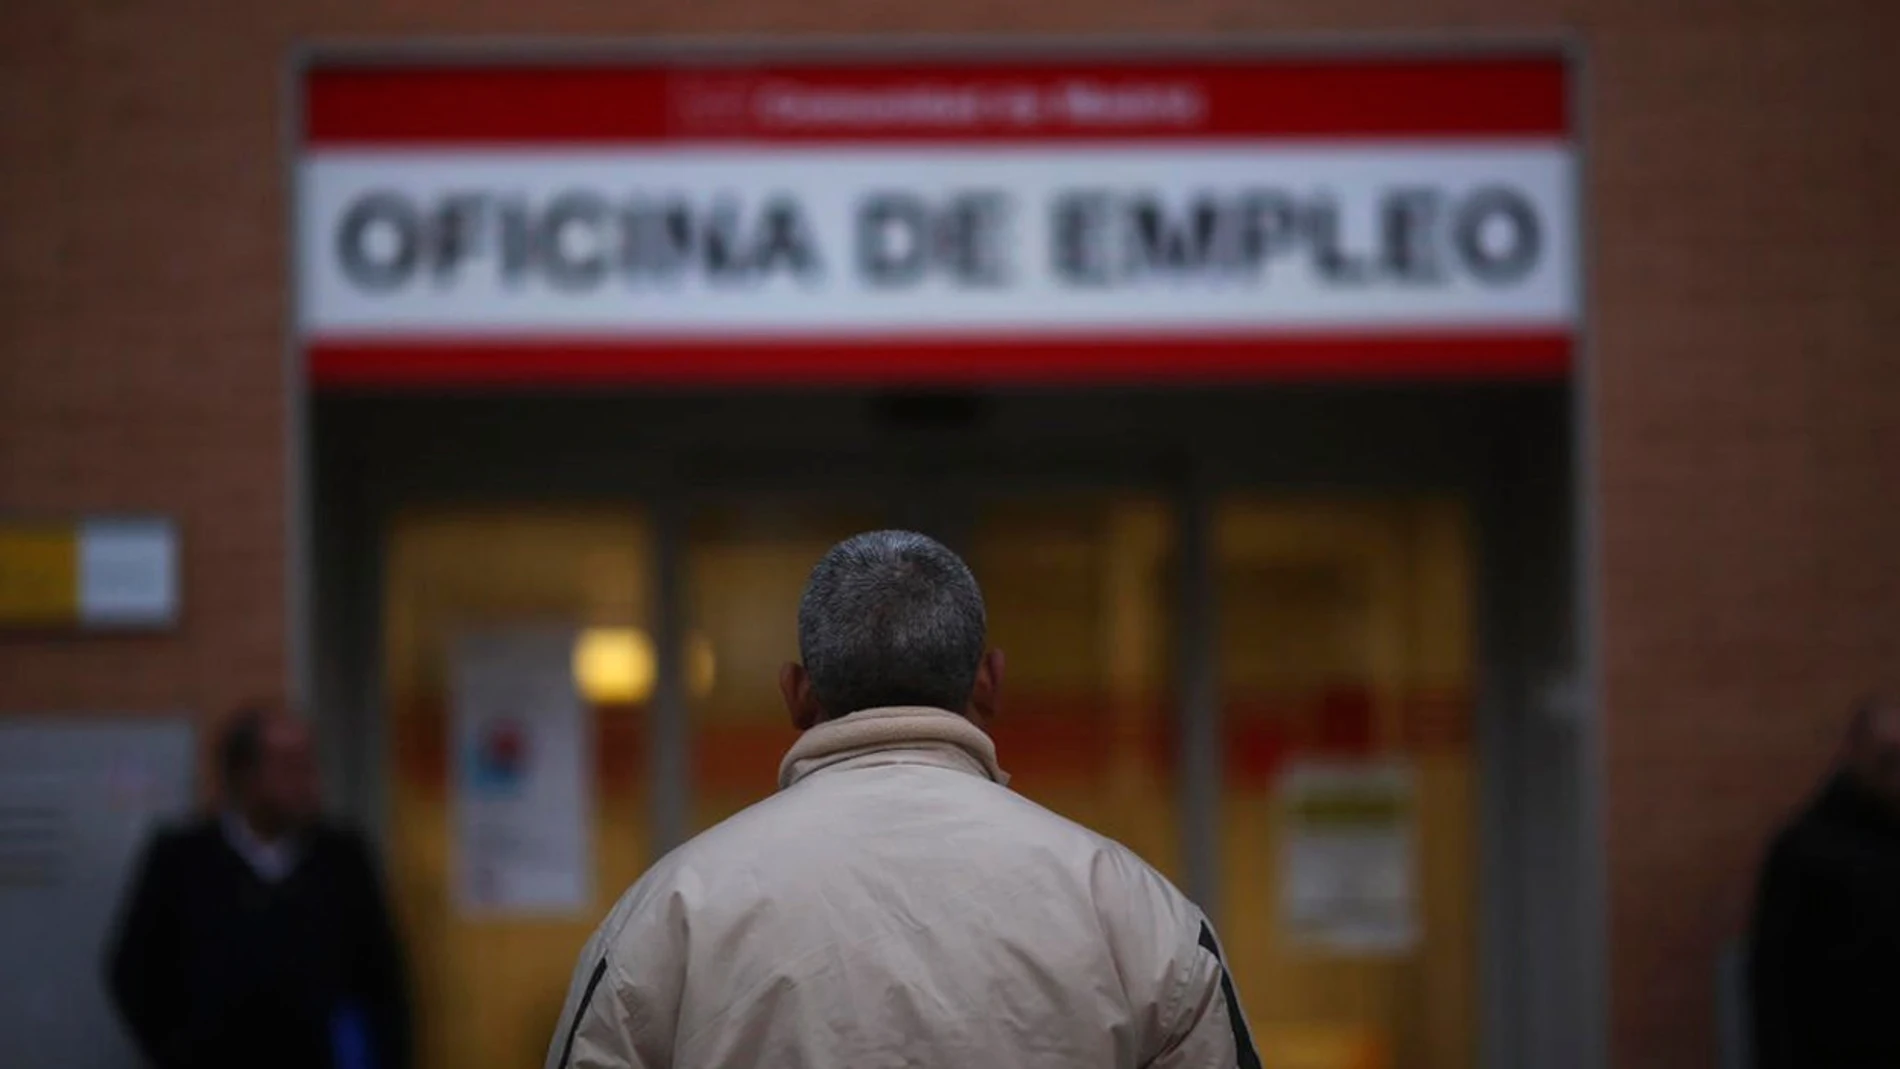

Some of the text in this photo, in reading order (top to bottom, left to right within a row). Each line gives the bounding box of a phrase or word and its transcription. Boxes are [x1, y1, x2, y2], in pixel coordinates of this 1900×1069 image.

[337, 186, 1542, 292] OFICINA DE EMPLEO
